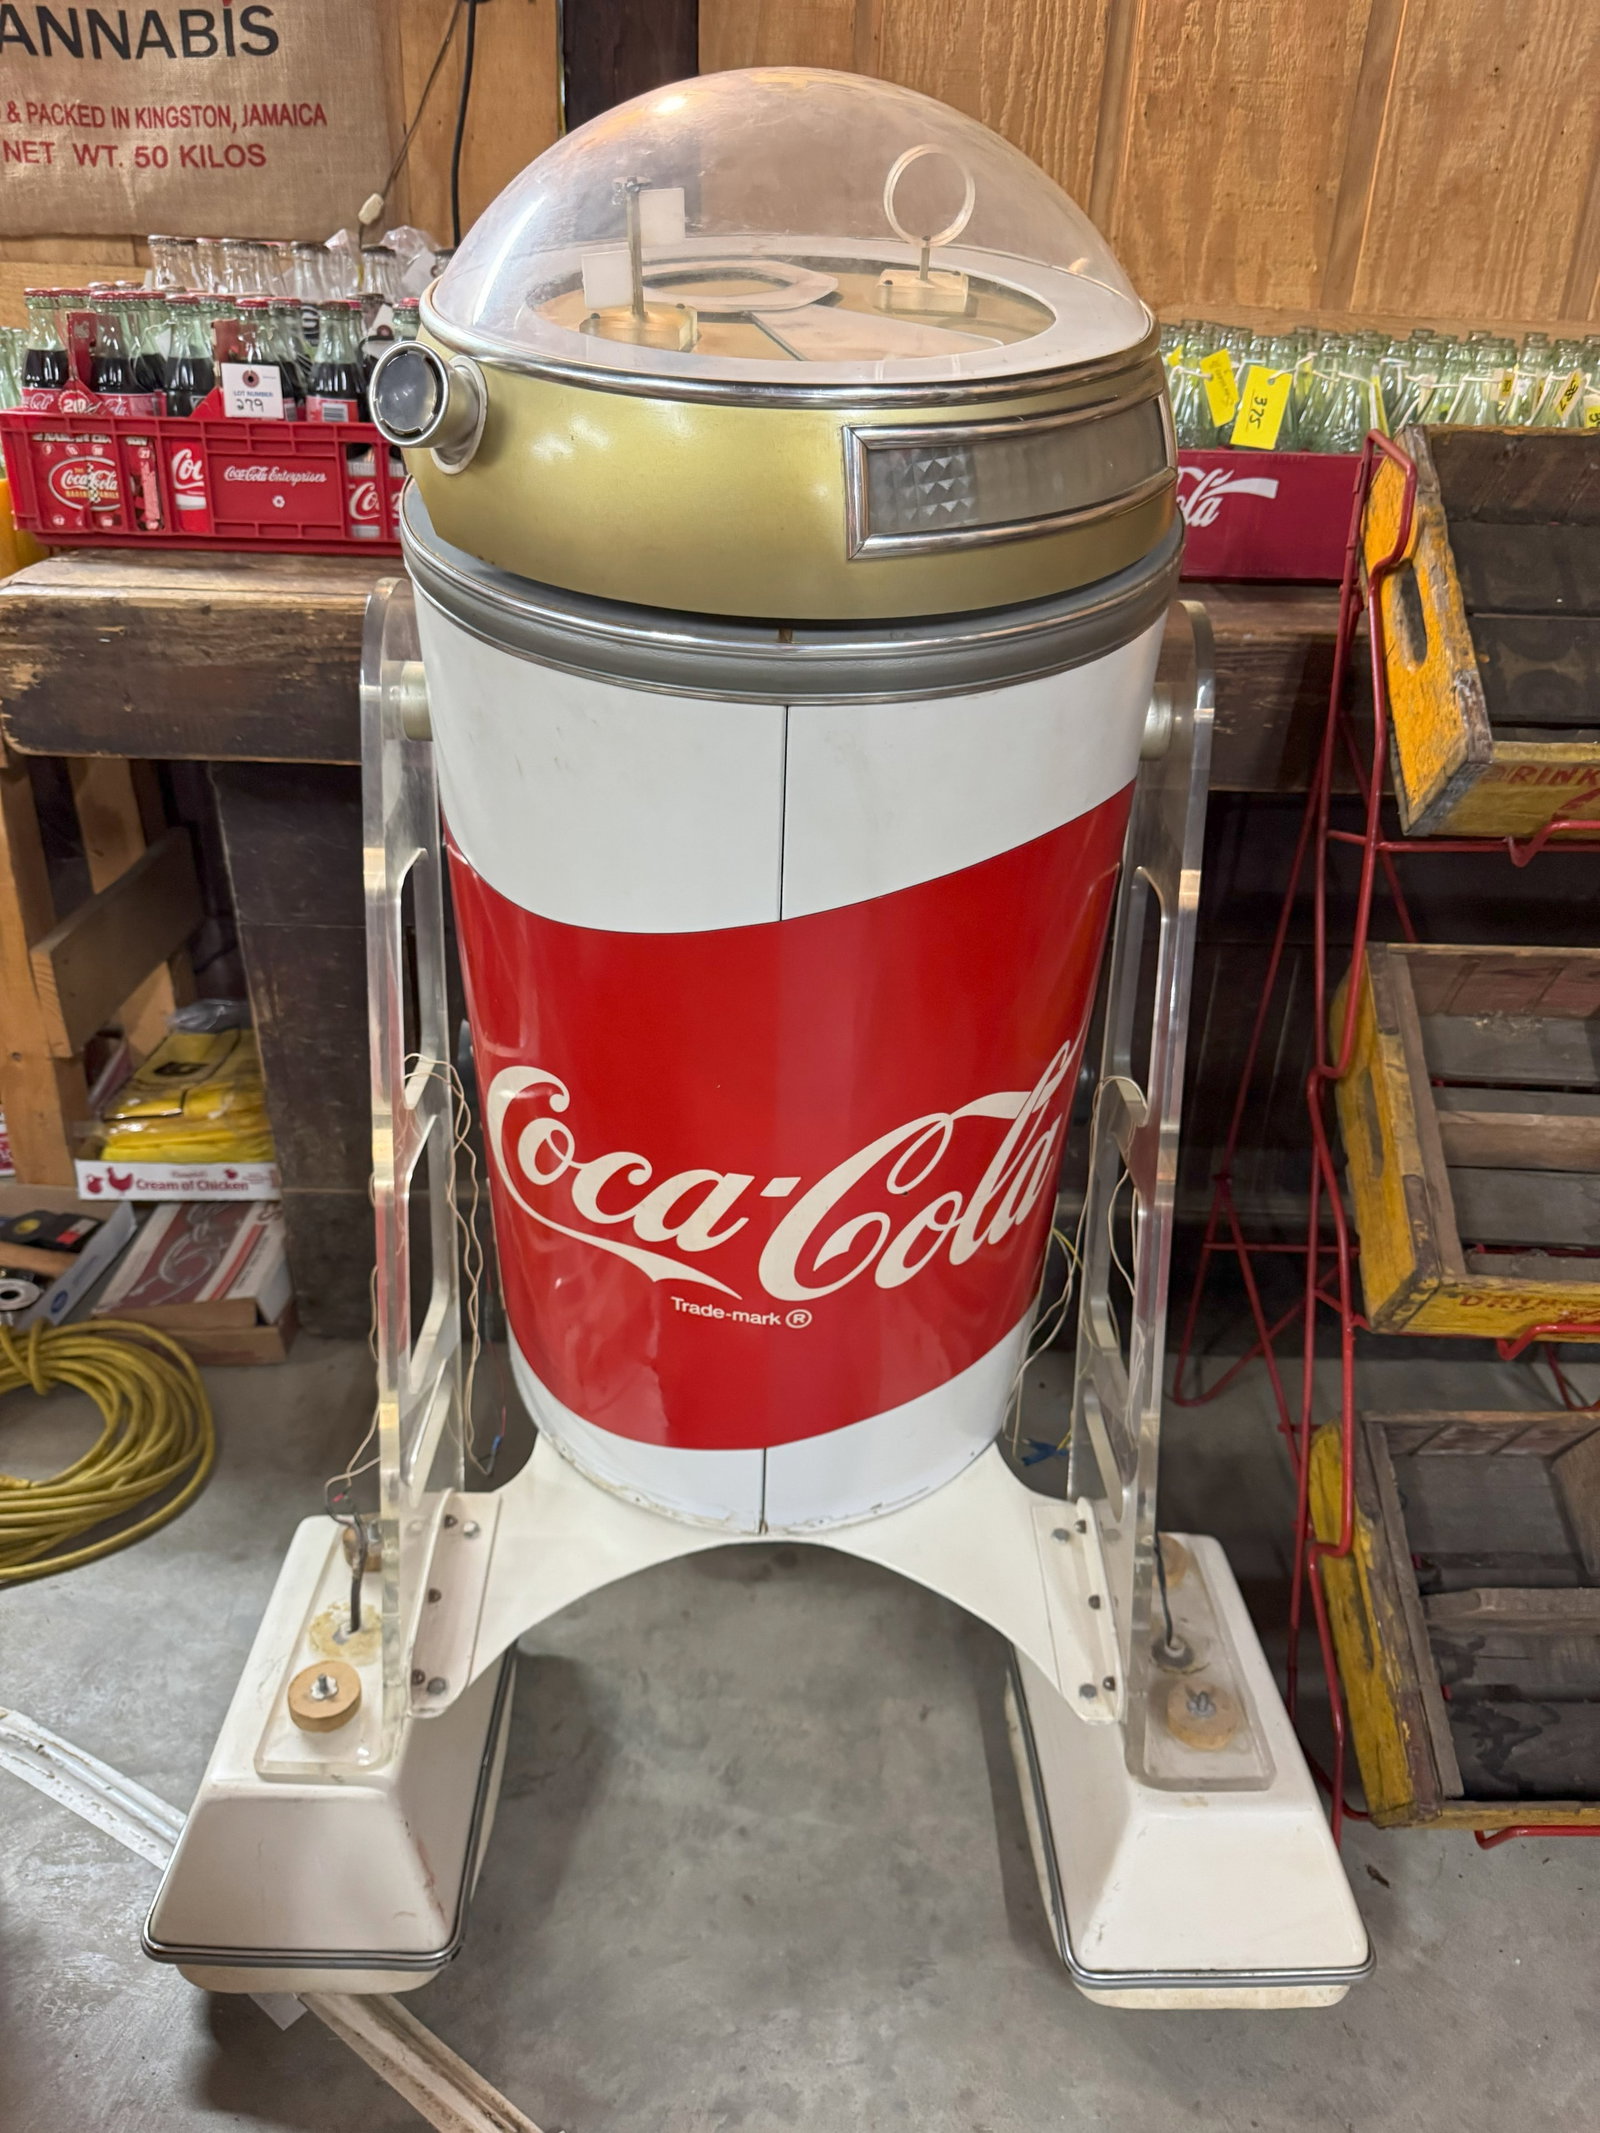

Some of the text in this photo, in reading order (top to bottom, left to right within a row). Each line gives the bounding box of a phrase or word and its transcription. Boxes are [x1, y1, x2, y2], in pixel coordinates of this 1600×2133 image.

[7, 102, 327, 133] & PACKED IN KINGSTON, JAMAICA
[3, 140, 267, 168] NET WT. 50 KILOS
[236, 398, 265, 412] 279
[1249, 396, 1268, 429] 375
[268, 465, 327, 487] Enterprises
[487, 1022, 1083, 1301] Coca-Cola
[136, 1179, 249, 1192] Cream of Chicken
[670, 1296, 782, 1326] Trade-mark
